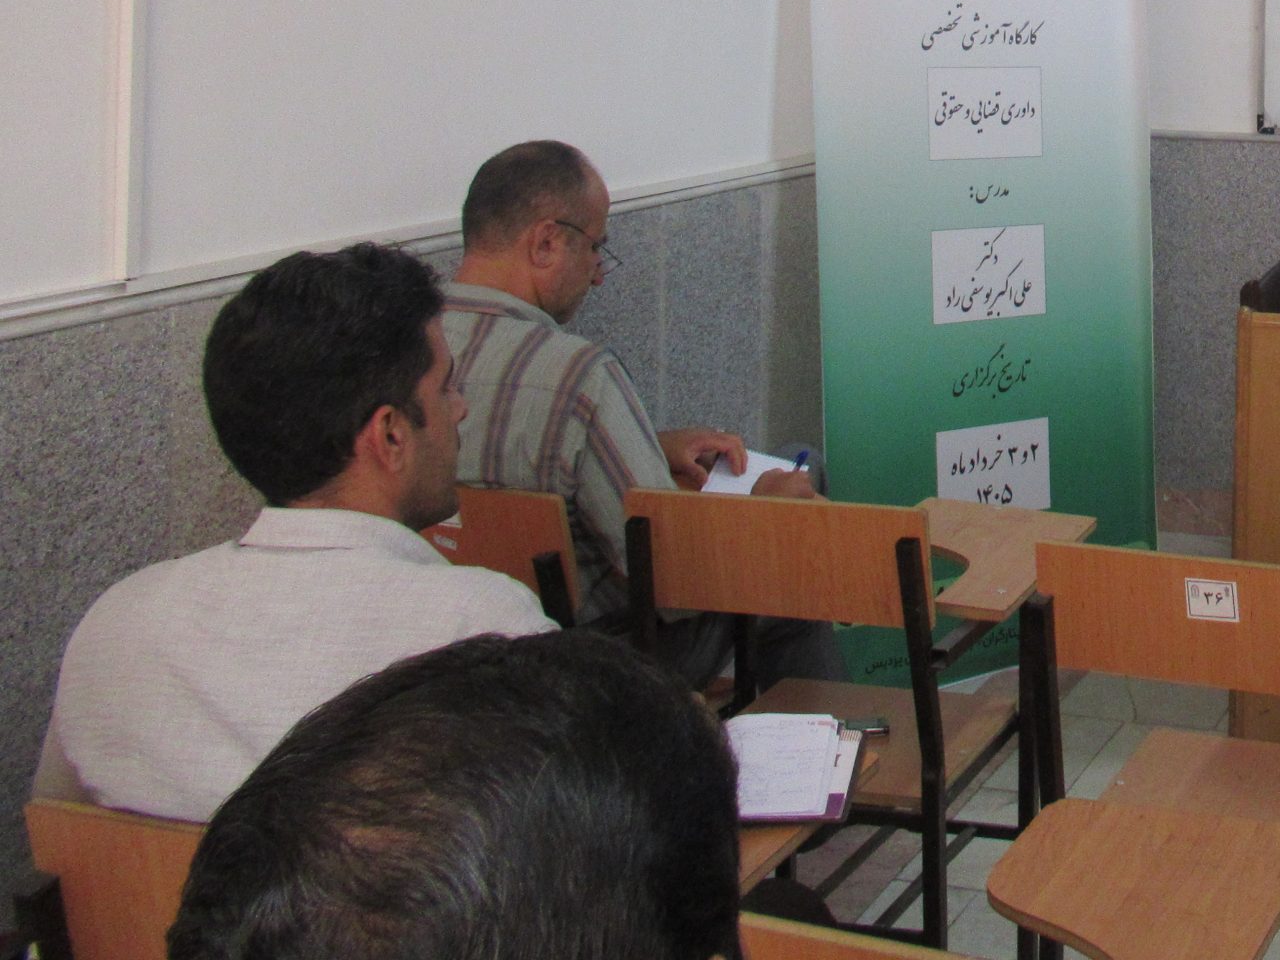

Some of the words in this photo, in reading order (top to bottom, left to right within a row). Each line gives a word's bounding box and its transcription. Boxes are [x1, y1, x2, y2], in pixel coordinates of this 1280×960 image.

[921, 2, 963, 51] تخصصی
[962, 12, 1013, 51] آموزشی
[1008, 20, 1045, 45] کارگاه
[934, 91, 964, 126] حقوقی
[1001, 99, 1035, 125] داوری
[975, 226, 1008, 272] دکتر
[952, 343, 1006, 399] برگزاری
[997, 353, 1031, 393] تاریخ
[977, 483, 1013, 505] ۱۴۰۵
[1203, 591, 1224, 606] ۳۶
